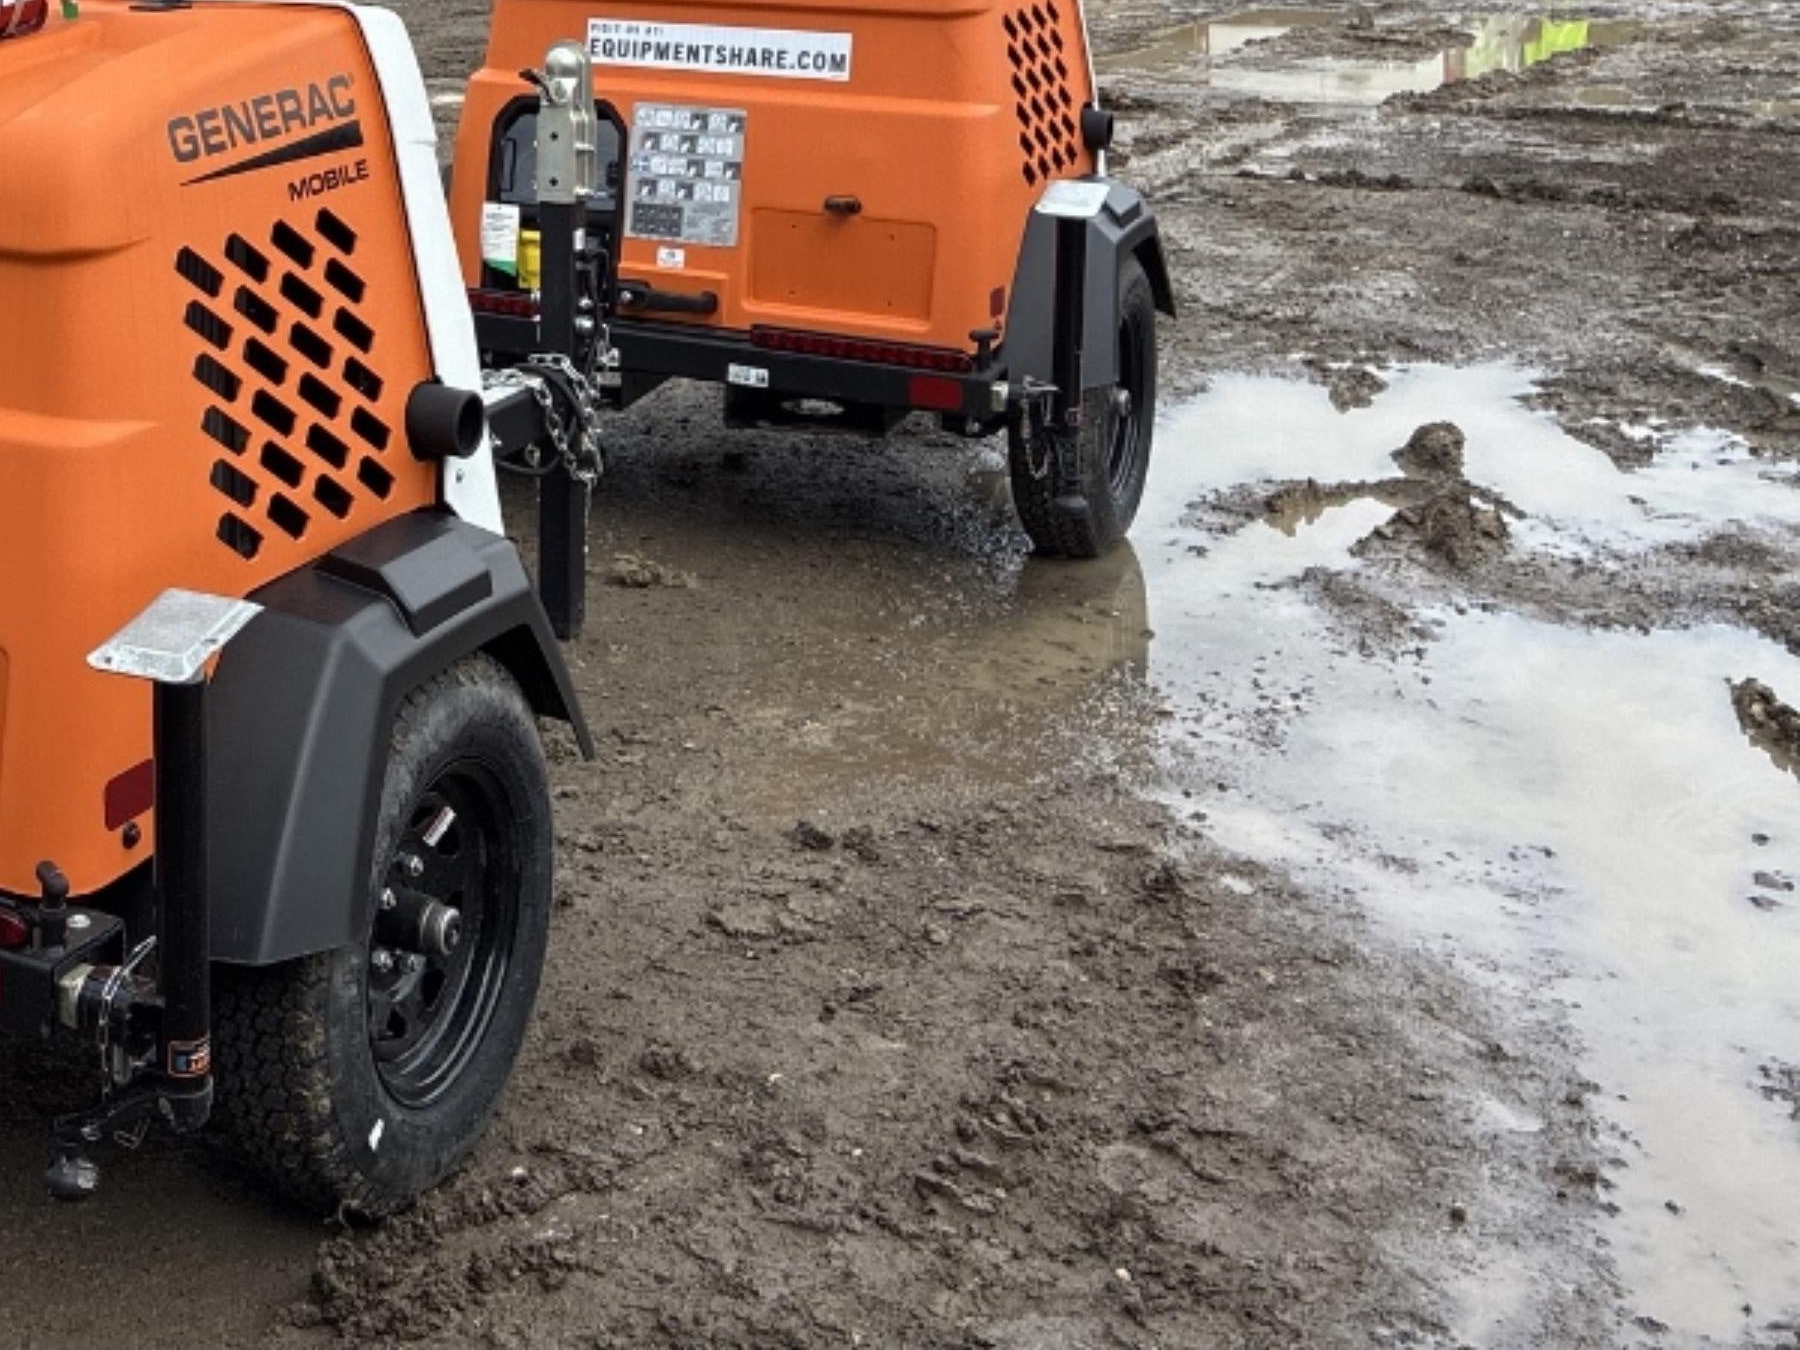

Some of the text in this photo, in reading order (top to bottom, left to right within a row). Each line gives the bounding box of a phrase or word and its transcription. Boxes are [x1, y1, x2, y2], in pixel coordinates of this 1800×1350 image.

[589, 37, 847, 74] EQUIPMENTSHARE.COM
[167, 74, 356, 162] GENERAC
[287, 160, 370, 201] MOBILE
